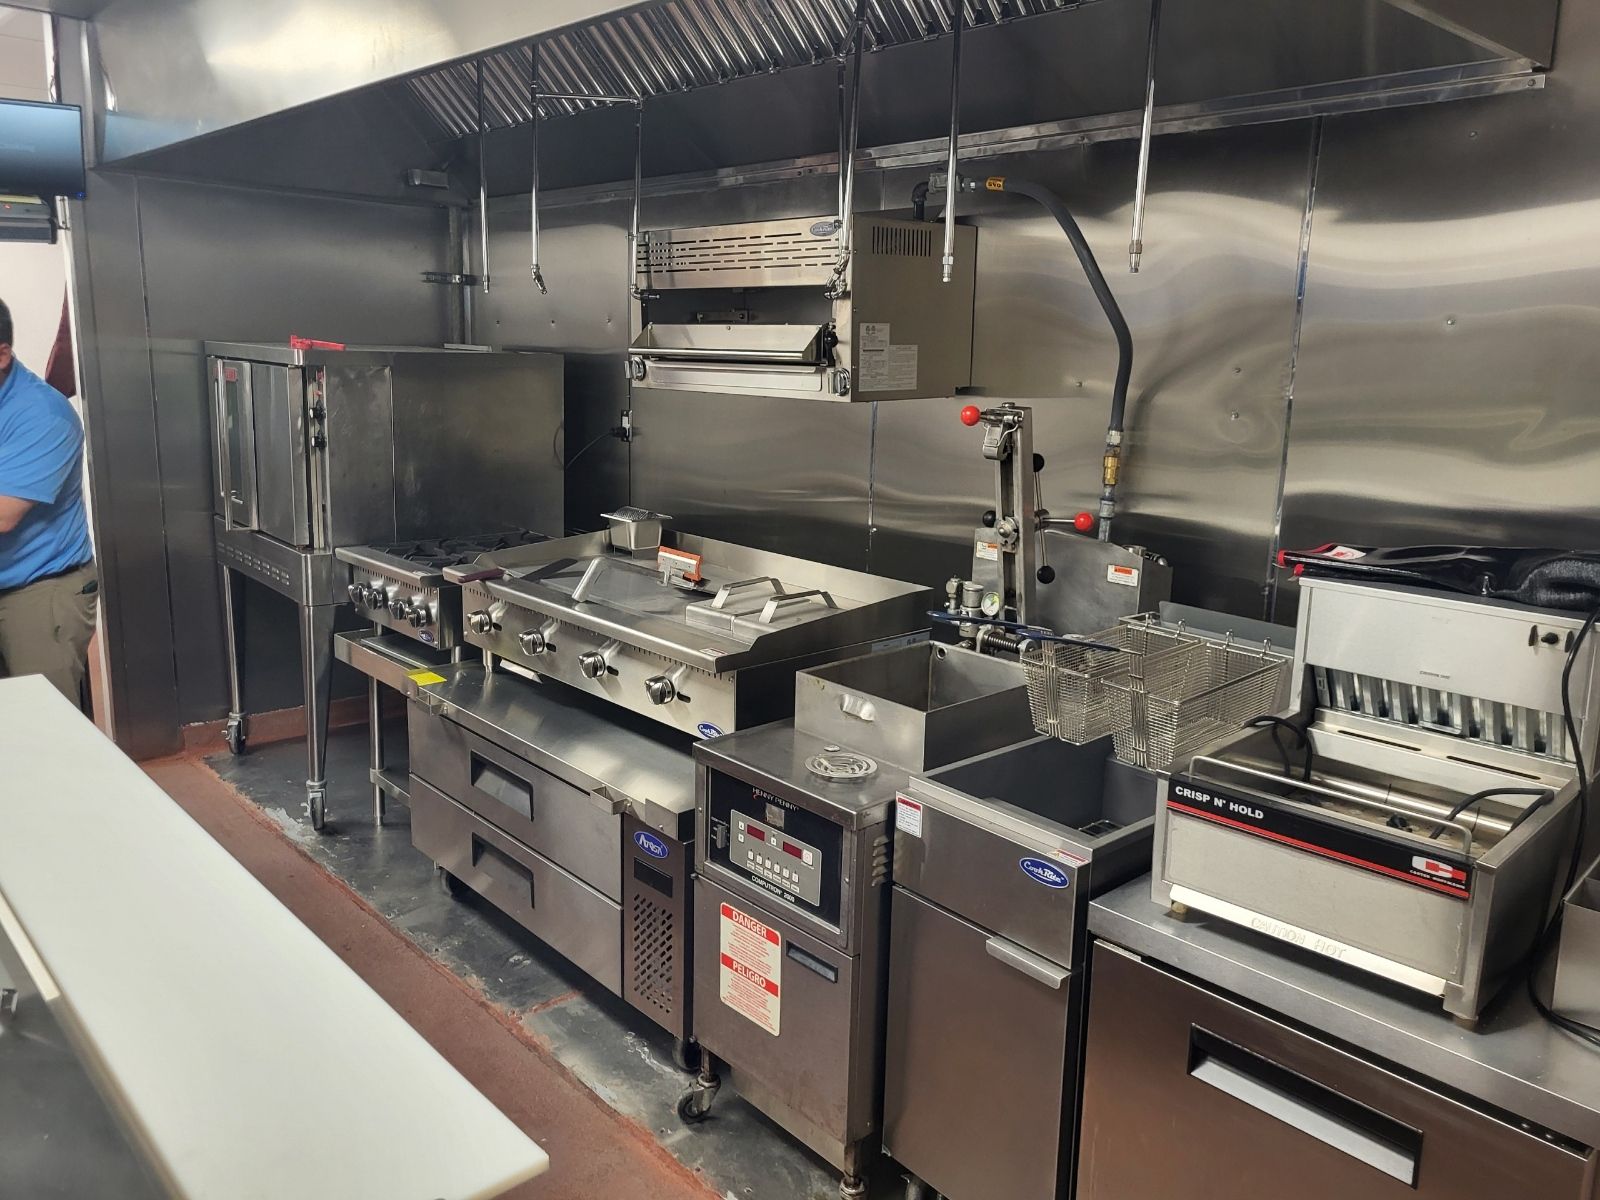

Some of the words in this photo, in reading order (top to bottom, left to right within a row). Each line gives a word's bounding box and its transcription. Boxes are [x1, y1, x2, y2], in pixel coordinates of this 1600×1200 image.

[752, 787, 774, 801] HENNY
[774, 797, 797, 811] PENNY
[1175, 786, 1211, 803] CRISP
[1213, 797, 1227, 808] N'
[1229, 802, 1265, 819] HOLD
[751, 875, 781, 895] COMPUTRON
[732, 910, 767, 938] DANGER
[1251, 917, 1306, 945] CAUTION
[1313, 938, 1347, 959] HOT
[732, 960, 766, 988] PELIGRO
